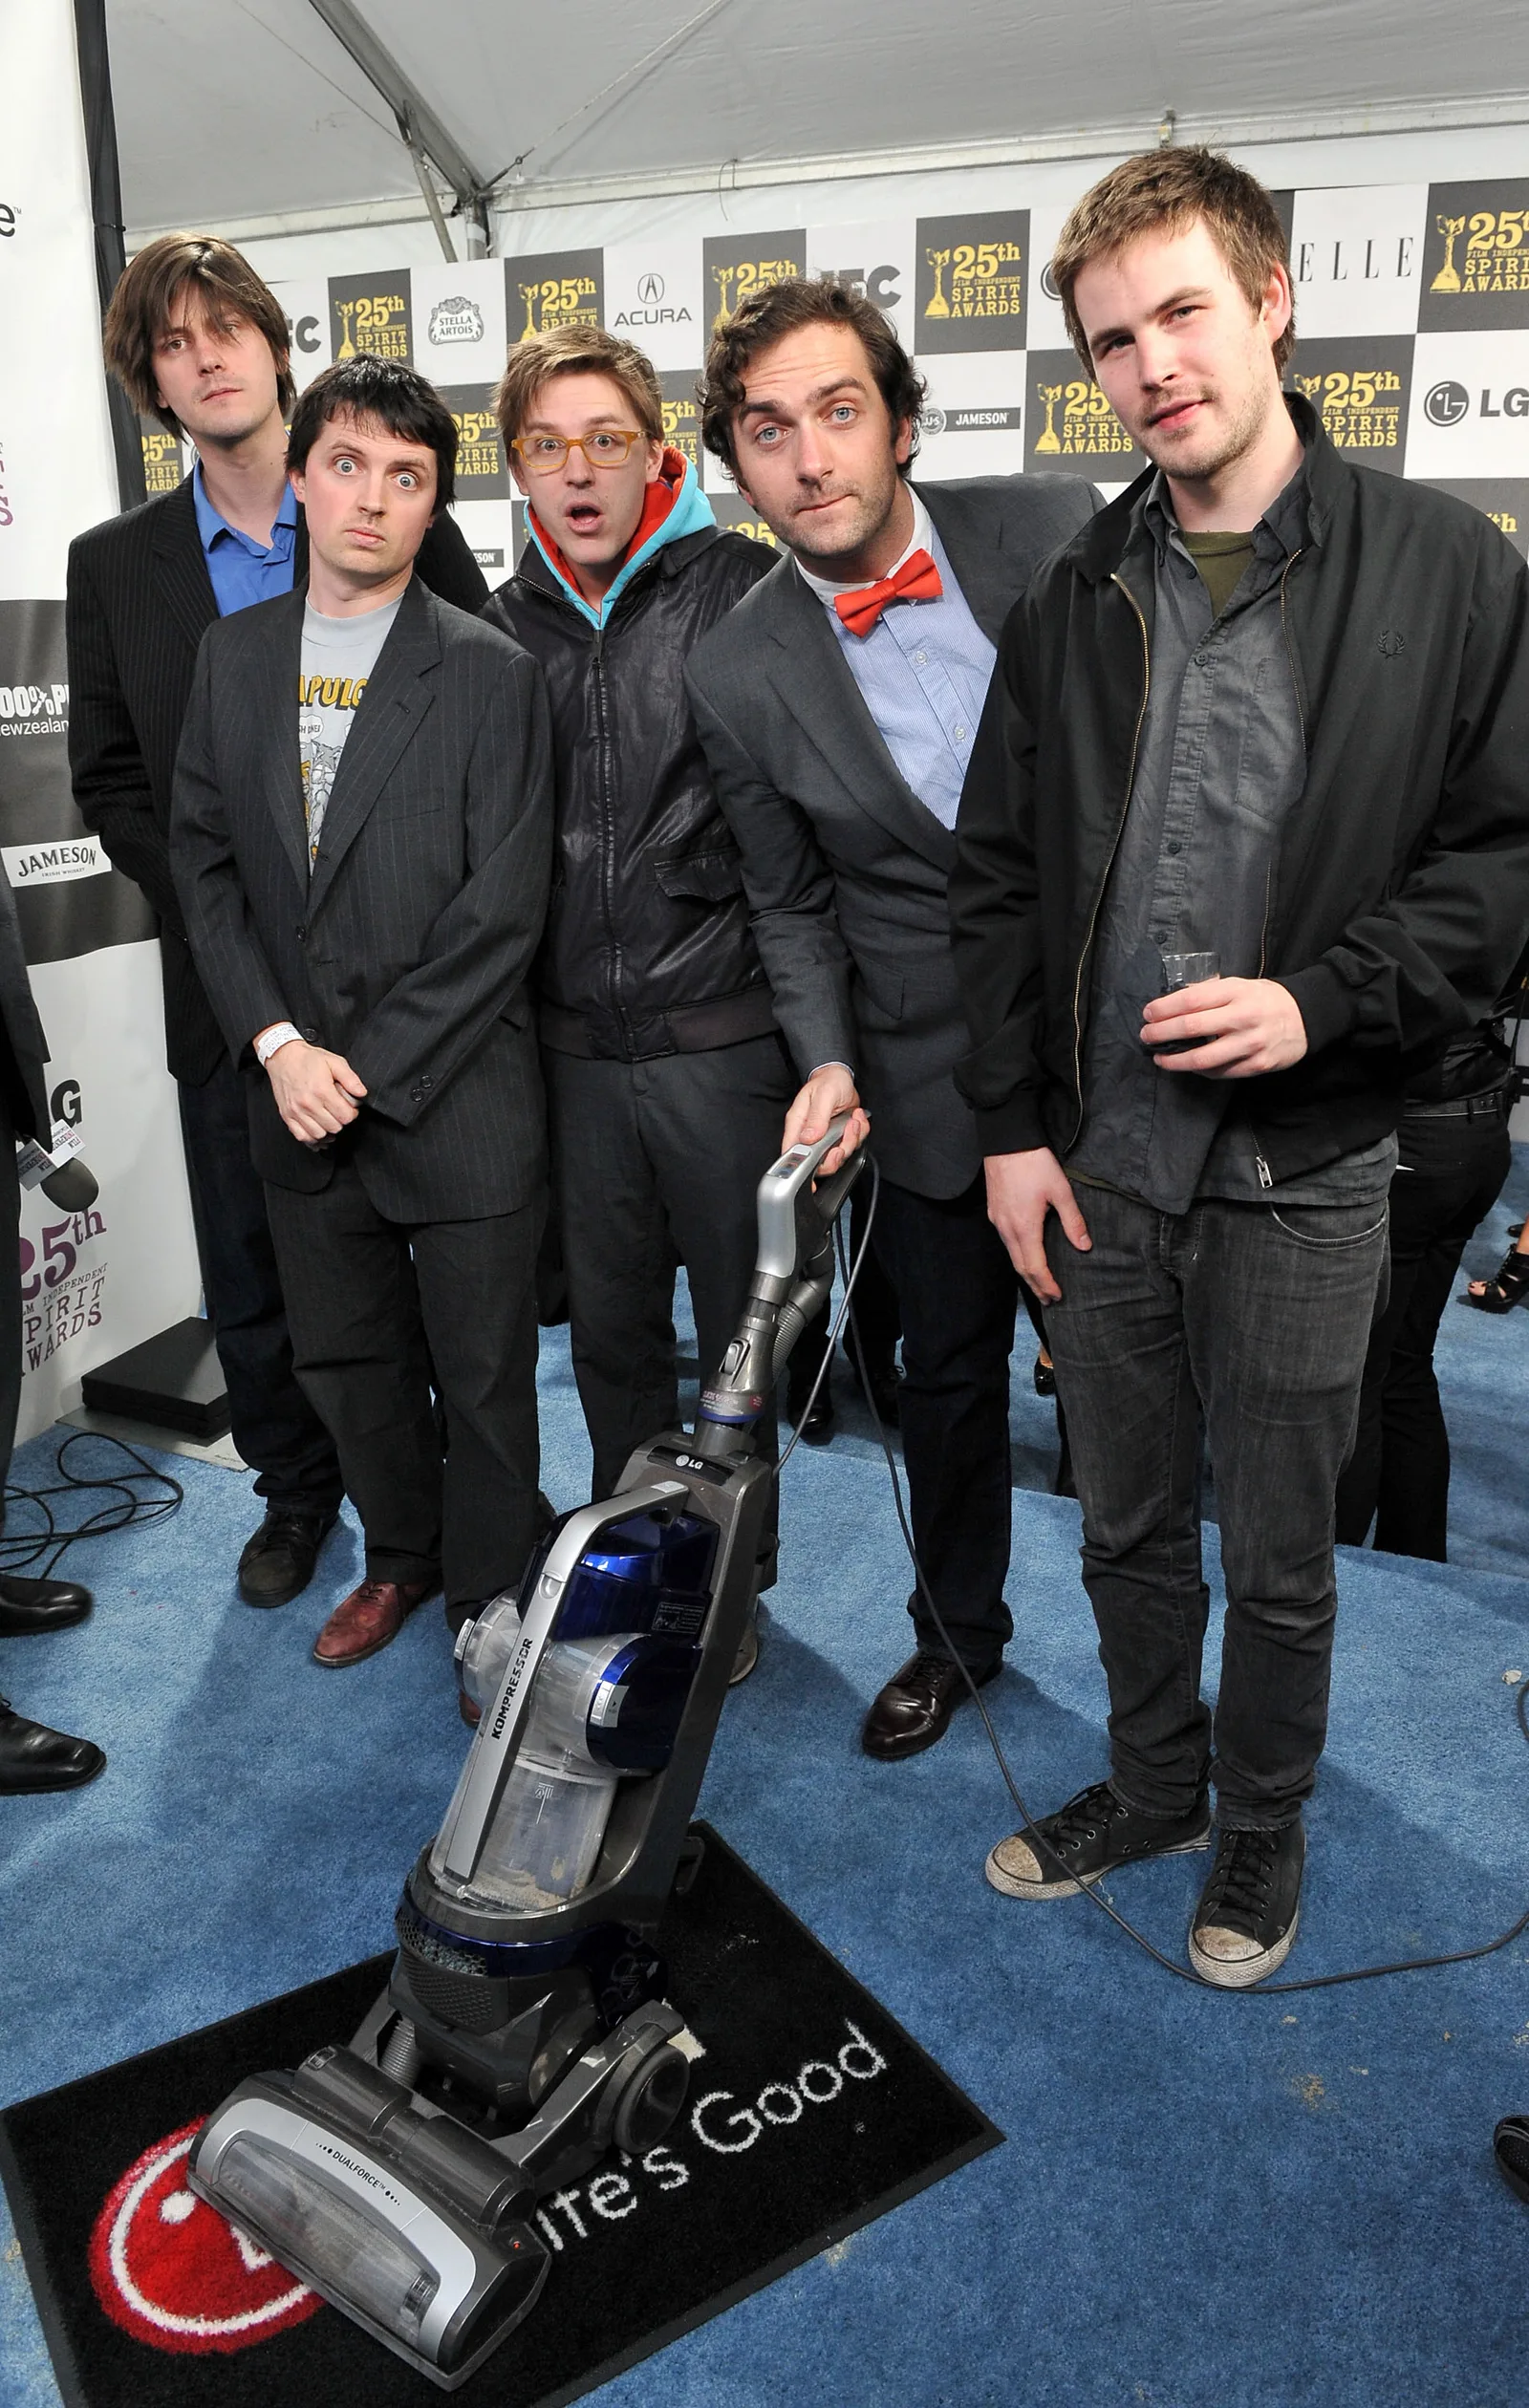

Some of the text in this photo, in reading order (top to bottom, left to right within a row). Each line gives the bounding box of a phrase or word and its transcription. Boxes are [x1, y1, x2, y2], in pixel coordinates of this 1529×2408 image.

[1468, 210, 1529, 251] 25t
[953, 242, 1021, 279] 25th
[1298, 236, 1413, 283] ELLE
[1465, 257, 1529, 275] SPIRI
[1462, 273, 1529, 292] AWARD
[541, 277, 596, 312] 25th
[952, 284, 1020, 302] SPIRIT
[355, 295, 405, 327] 25th
[614, 308, 692, 327] ACURA
[951, 299, 1021, 318] AWARDS
[440, 315, 472, 326] STELLA
[356, 330, 407, 347] SPIRIT
[440, 326, 473, 335] ARTOIS
[1065, 381, 1110, 416] 25
[1323, 371, 1401, 409] 25th
[1346, 406, 1400, 415] INDEPENDENT
[1479, 388, 1529, 418] LG
[661, 401, 696, 433] 5th
[956, 412, 1007, 426] JAMESON
[1322, 415, 1398, 432] SPIRIT
[1063, 422, 1129, 439] SPIRI
[1332, 431, 1397, 447] WARDS
[456, 447, 498, 462] PIRIT
[1062, 438, 1133, 453] AWARDS
[455, 461, 499, 476] WARDS
[0, 685, 55, 719] 00%
[0, 717, 69, 736] ewzealan
[18, 847, 97, 877] JAMESON
[51, 1079, 82, 1129] G
[43, 1262, 108, 1307] INDEPENDENT
[24, 1277, 105, 1344] PIRIT
[21, 1301, 102, 1377] WARDS
[688, 1459, 703, 1470] LG
[491, 1637, 533, 1739] KOMPRESSOR
[691, 2017, 887, 2153] Good
